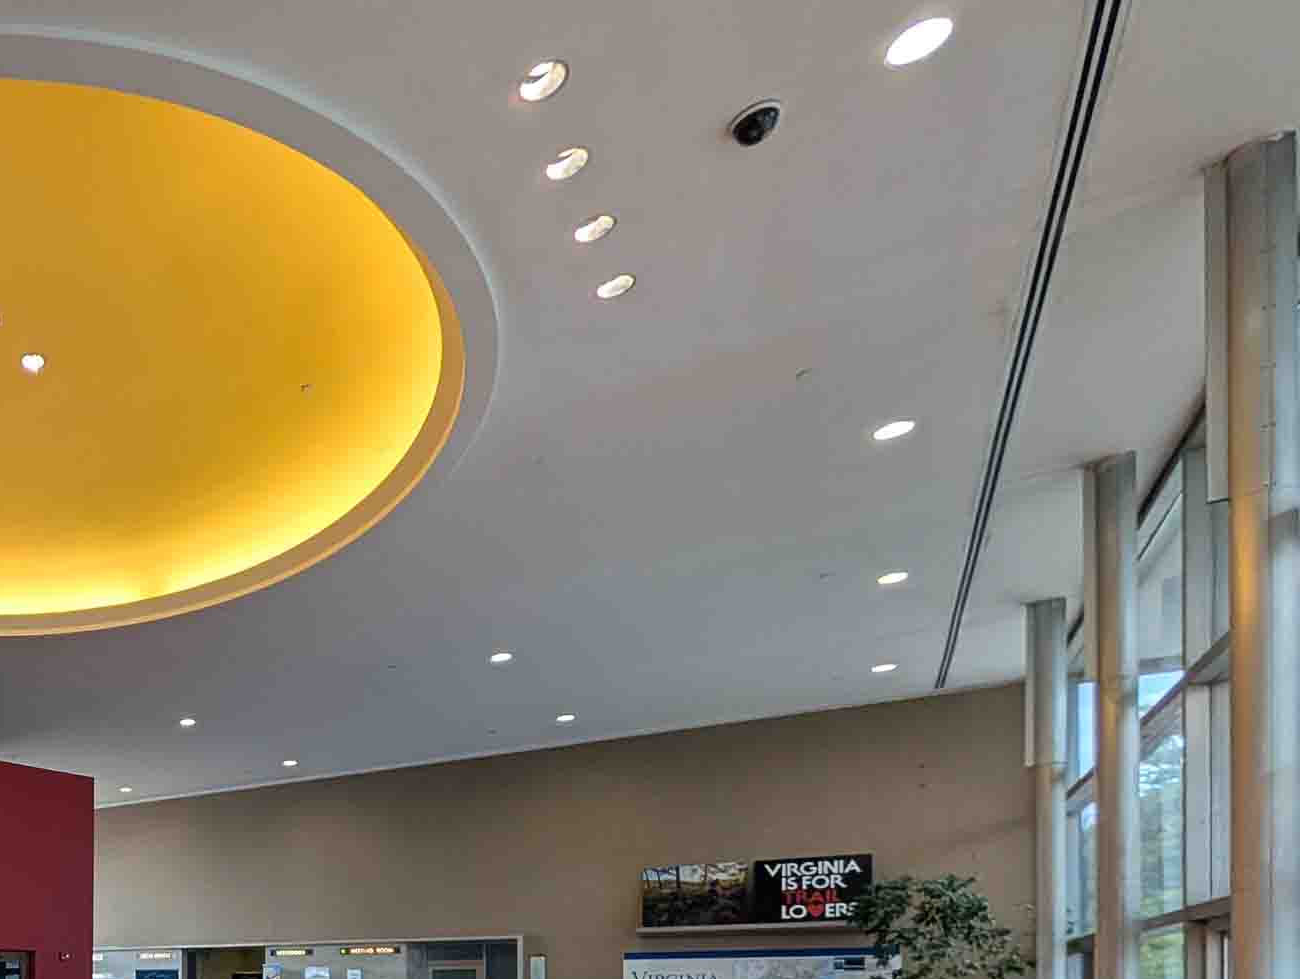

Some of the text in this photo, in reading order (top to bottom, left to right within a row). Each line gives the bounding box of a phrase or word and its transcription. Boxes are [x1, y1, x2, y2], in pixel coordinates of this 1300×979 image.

[764, 859, 862, 878] VIRGINIA
[781, 874, 848, 891] IS FOR
